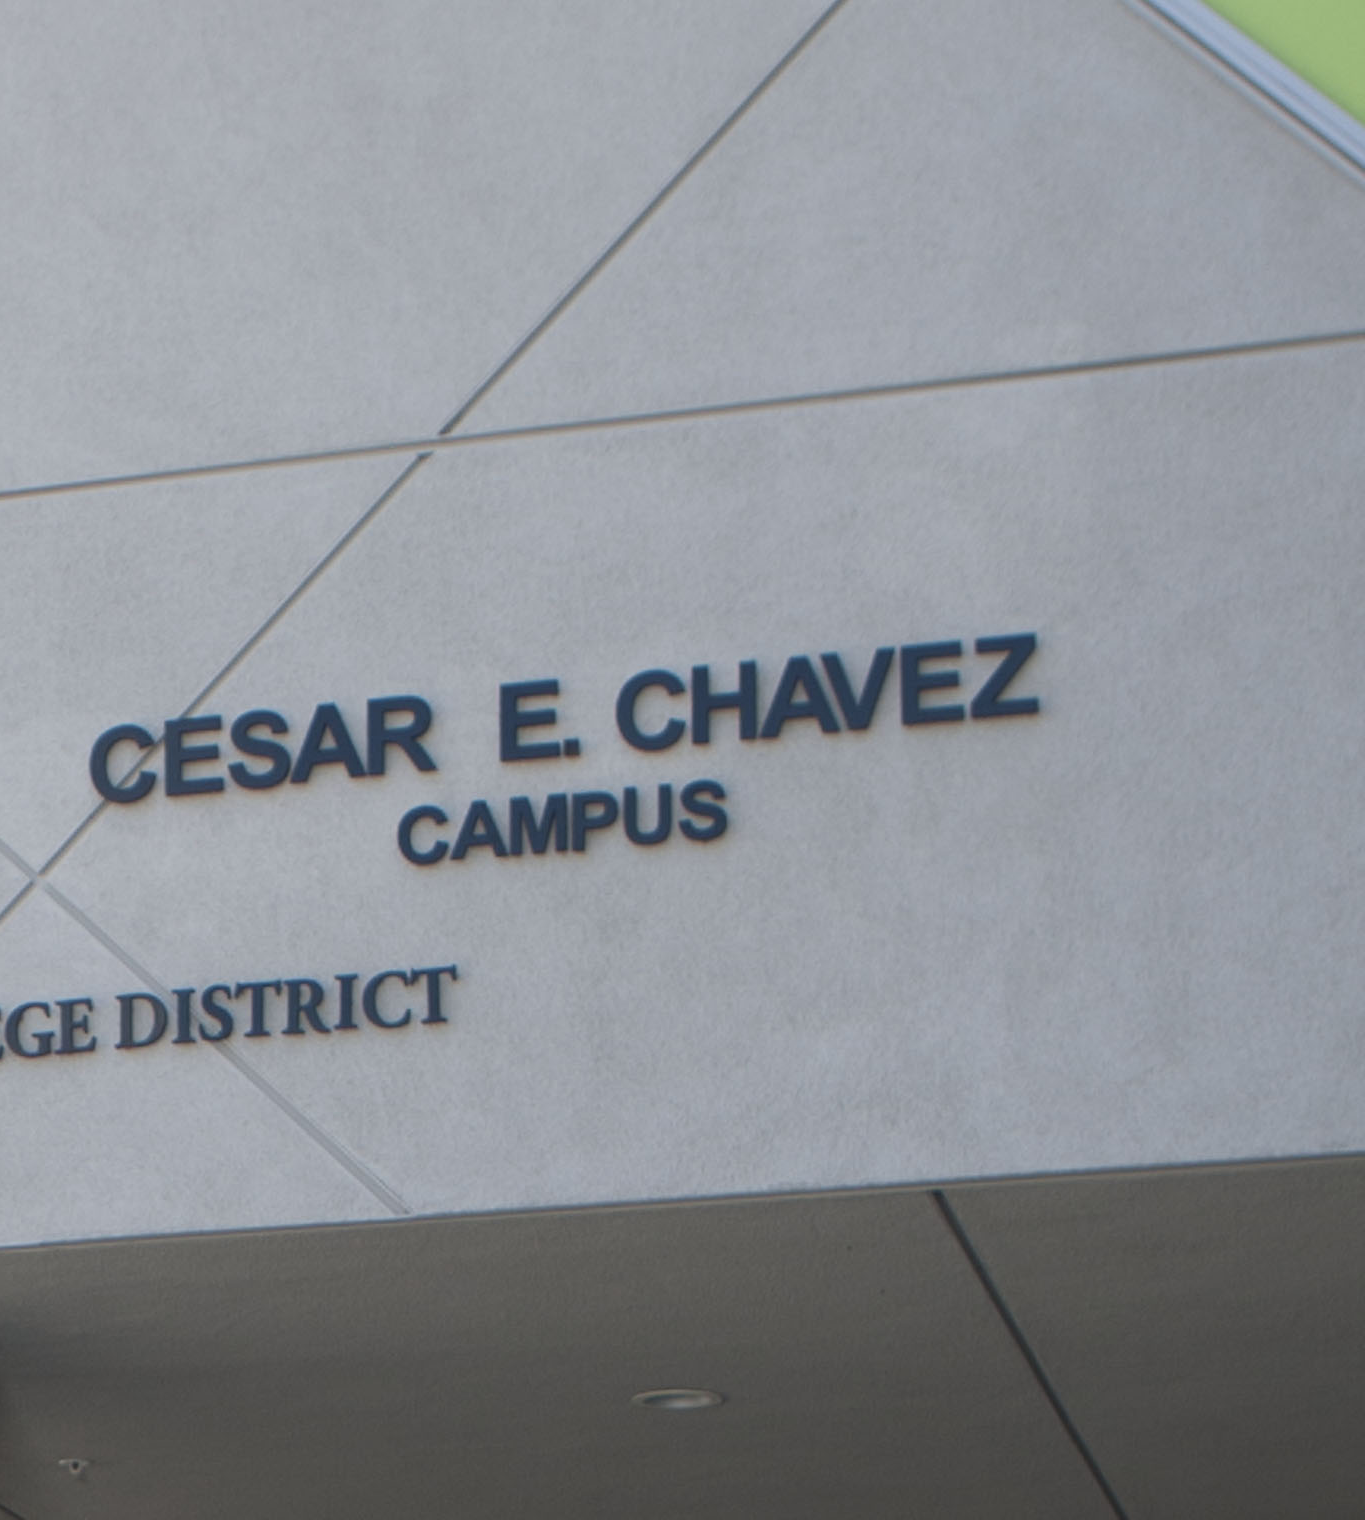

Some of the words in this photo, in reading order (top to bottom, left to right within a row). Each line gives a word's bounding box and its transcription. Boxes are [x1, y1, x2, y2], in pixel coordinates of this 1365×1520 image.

[88, 695, 440, 804] CESAR
[498, 678, 583, 765] E.
[615, 632, 1044, 755] CHAVEZ
[397, 779, 732, 869] CAMPUS
[114, 963, 461, 1052] DISTRICT
